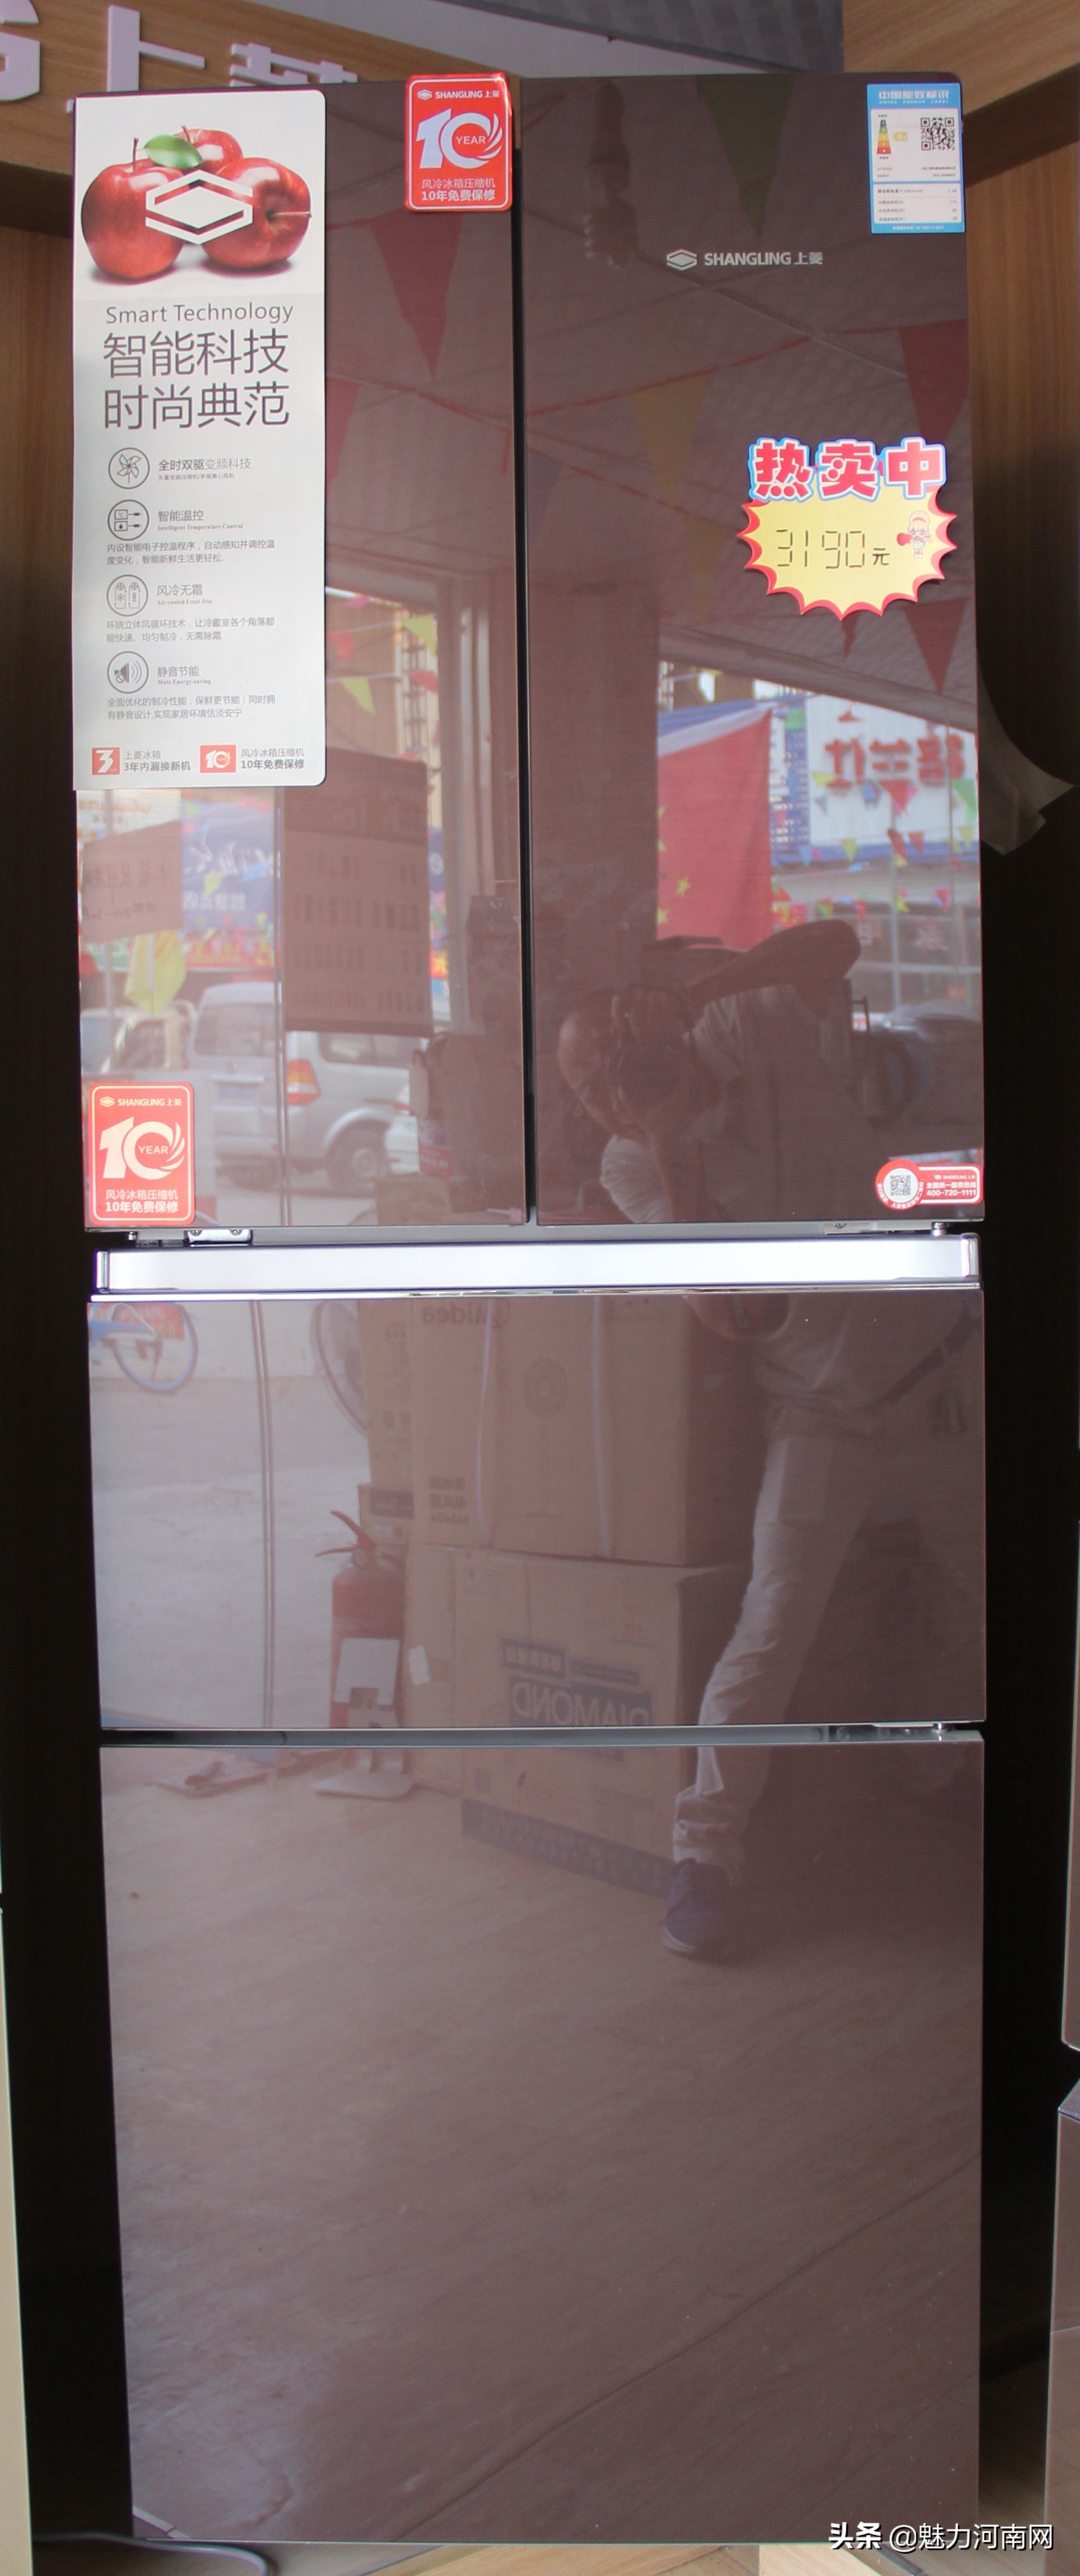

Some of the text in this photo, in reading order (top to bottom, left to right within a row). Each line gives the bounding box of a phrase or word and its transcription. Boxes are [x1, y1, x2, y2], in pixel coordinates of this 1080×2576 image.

[435, 90, 483, 99] SHANGLING
[416, 108, 503, 169] 10
[456, 136, 486, 145] YEAR
[422, 177, 496, 189] 风冷冰箱压缩机
[422, 189, 496, 201] 10年免费保修
[704, 251, 823, 265] SHANGLING 上菱
[106, 302, 294, 324] Smart Technology
[103, 328, 289, 378] 智能科技
[104, 381, 290, 430] 时尚典范
[158, 457, 251, 471] 全时双驱变频科技
[753, 439, 943, 499] 热卖中
[158, 510, 204, 522] 智能温控
[157, 584, 204, 596] 风冷无霜
[157, 666, 199, 677] 静音节能
[124, 750, 161, 760] 上菱冰箱
[241, 748, 305, 758] 风冷冰箱压缩机
[124, 761, 191, 772] 3年内漏换新机
[241, 759, 305, 769] 10年免费保修
[117, 1098, 165, 1107] SHANGLING
[99, 1116, 185, 1180] 10
[138, 1146, 169, 1154] YEAR
[105, 1189, 178, 1200] 风冷冰箱压缩机
[105, 1200, 178, 1213] 10年免费保修
